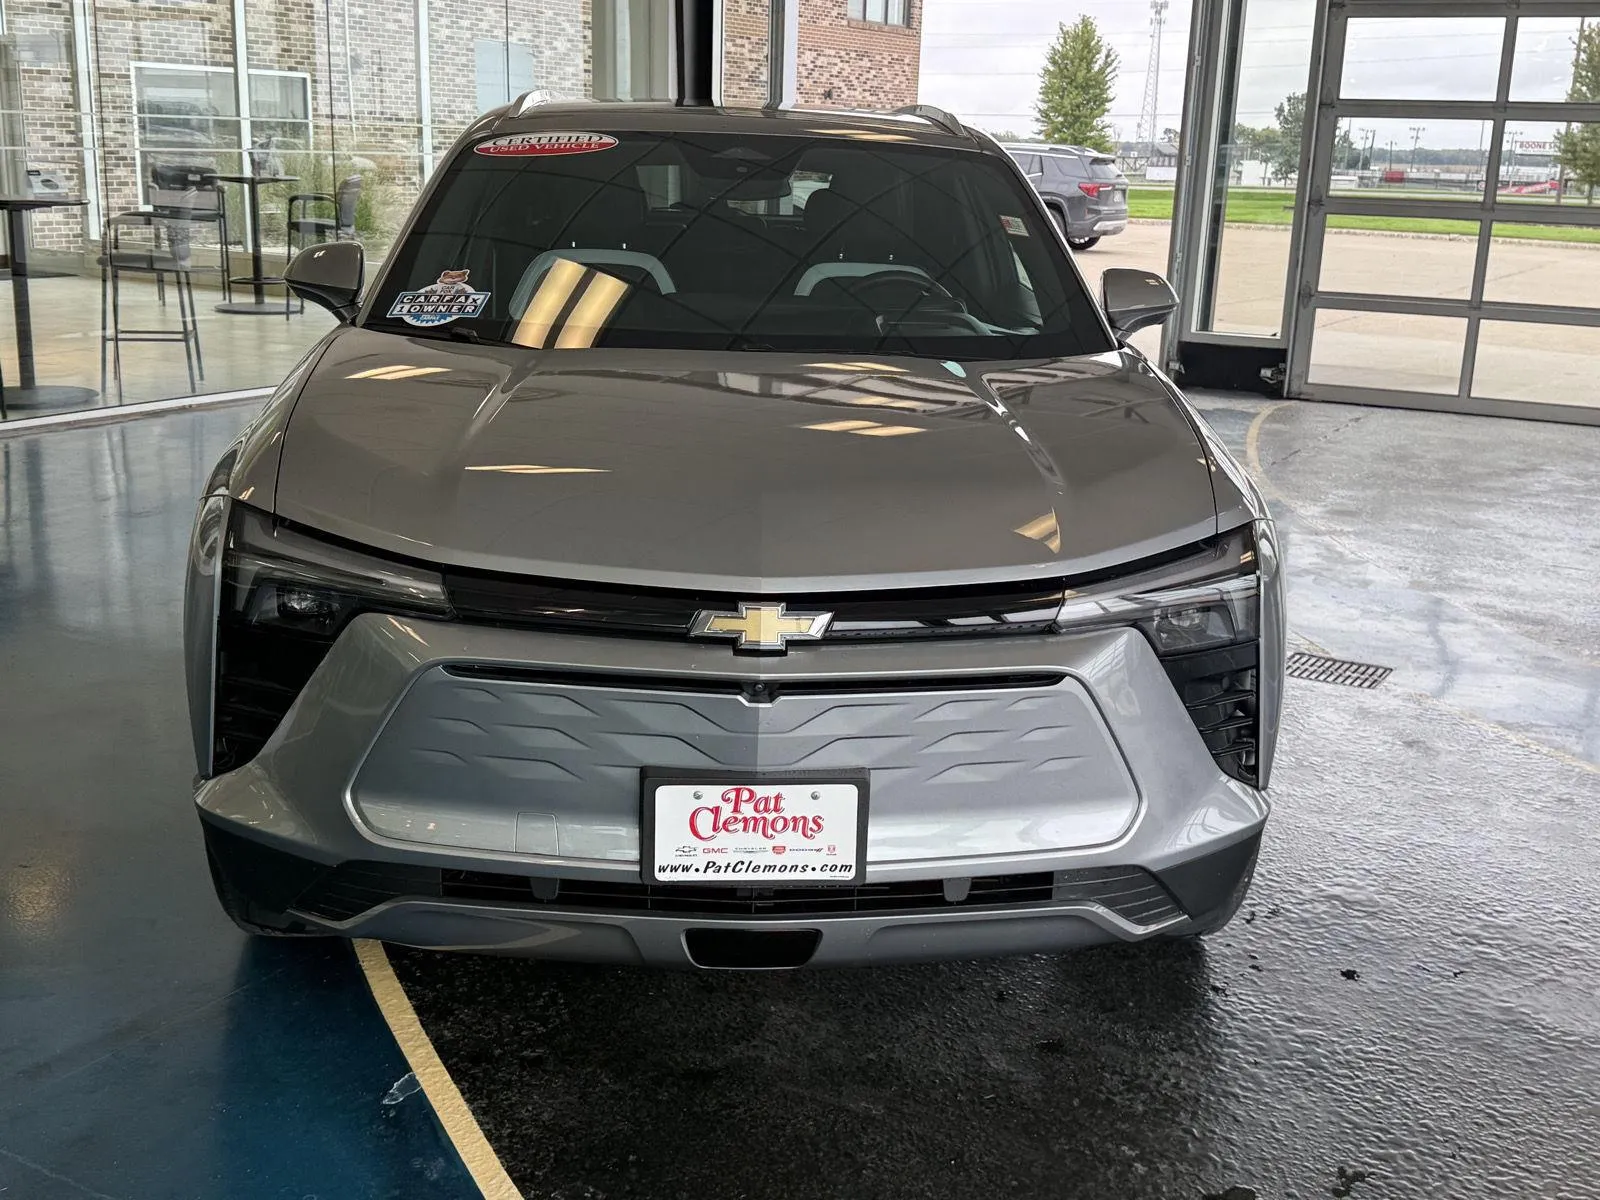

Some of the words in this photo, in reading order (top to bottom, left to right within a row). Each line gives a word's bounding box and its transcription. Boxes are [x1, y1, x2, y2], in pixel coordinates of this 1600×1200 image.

[492, 135, 604, 147] CERTIFIED
[1519, 141, 1546, 150] BOONE
[489, 144, 529, 153] USED
[532, 142, 599, 150] VEHICLE
[402, 295, 479, 304] CARFAX
[410, 305, 475, 313] OWNER
[721, 787, 786, 815] Pat
[688, 805, 825, 842] Clemons
[657, 860, 853, 874] www.PatClemons.com
